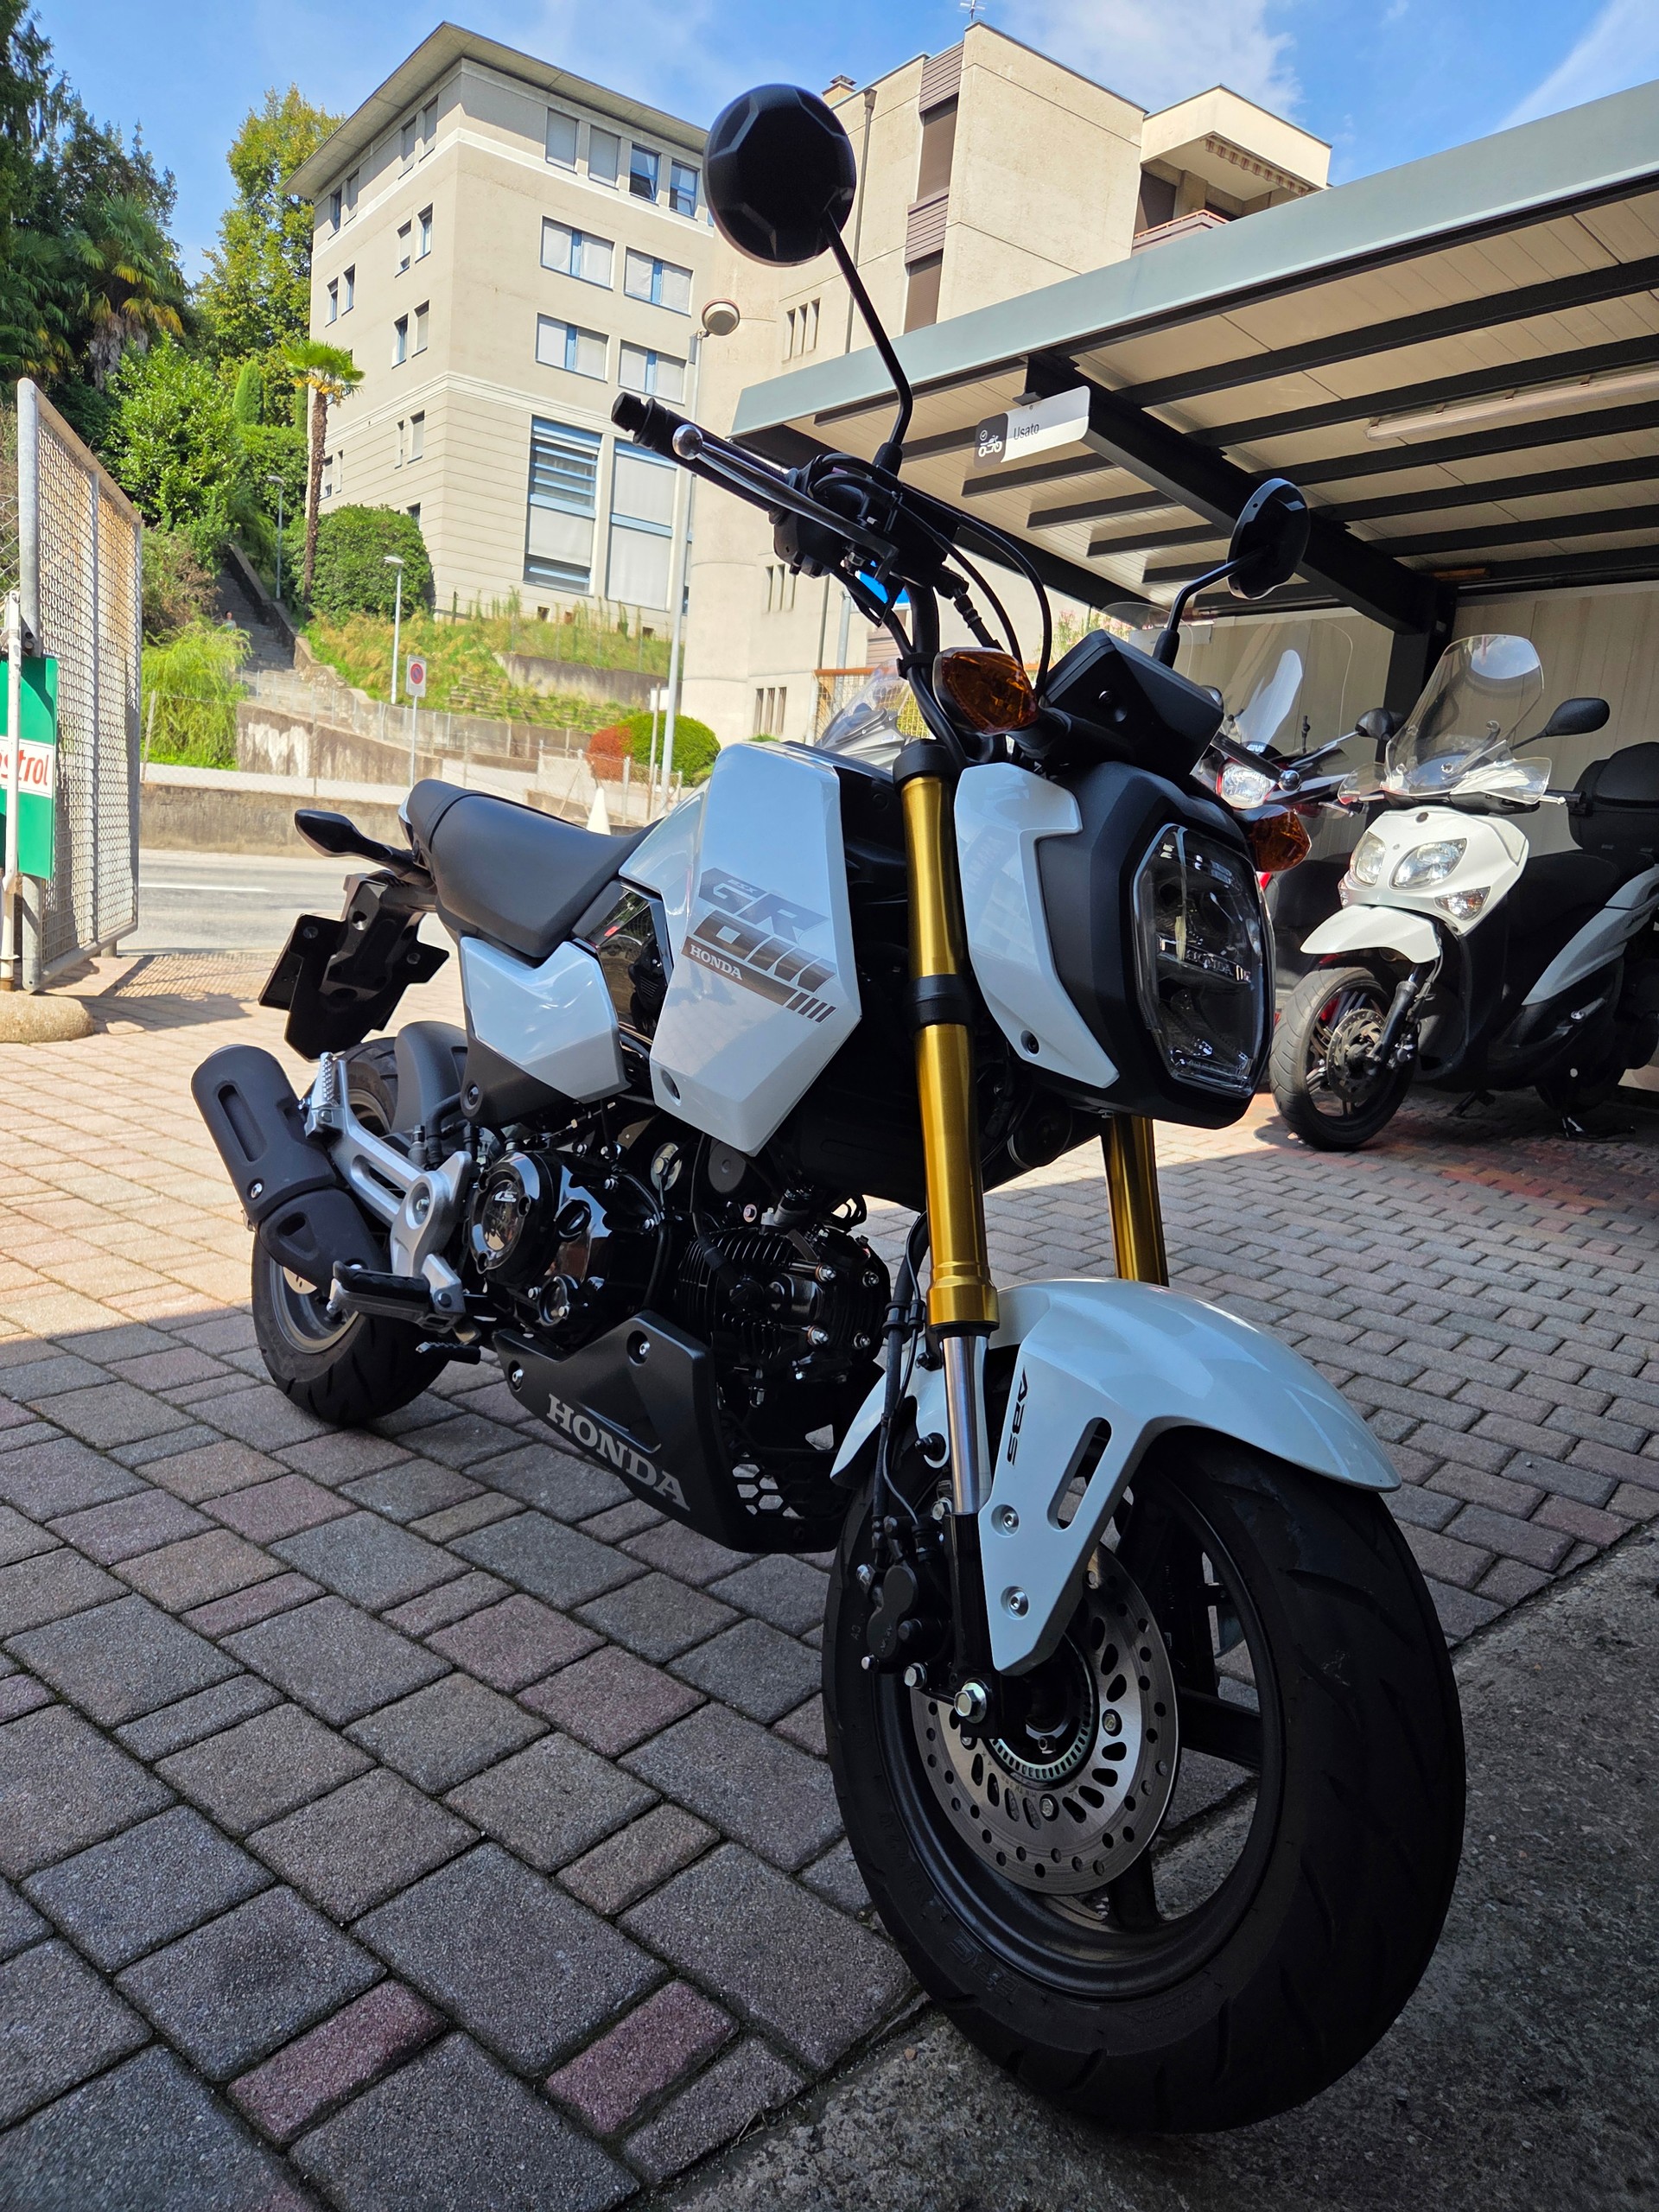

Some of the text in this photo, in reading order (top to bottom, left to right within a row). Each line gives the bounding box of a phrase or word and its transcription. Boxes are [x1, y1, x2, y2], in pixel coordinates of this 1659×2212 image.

[1014, 423, 1039, 441] Usato
[690, 944, 743, 981] HONDA
[1007, 1365, 1028, 1466] ABS
[546, 1393, 690, 1511] HONDA
